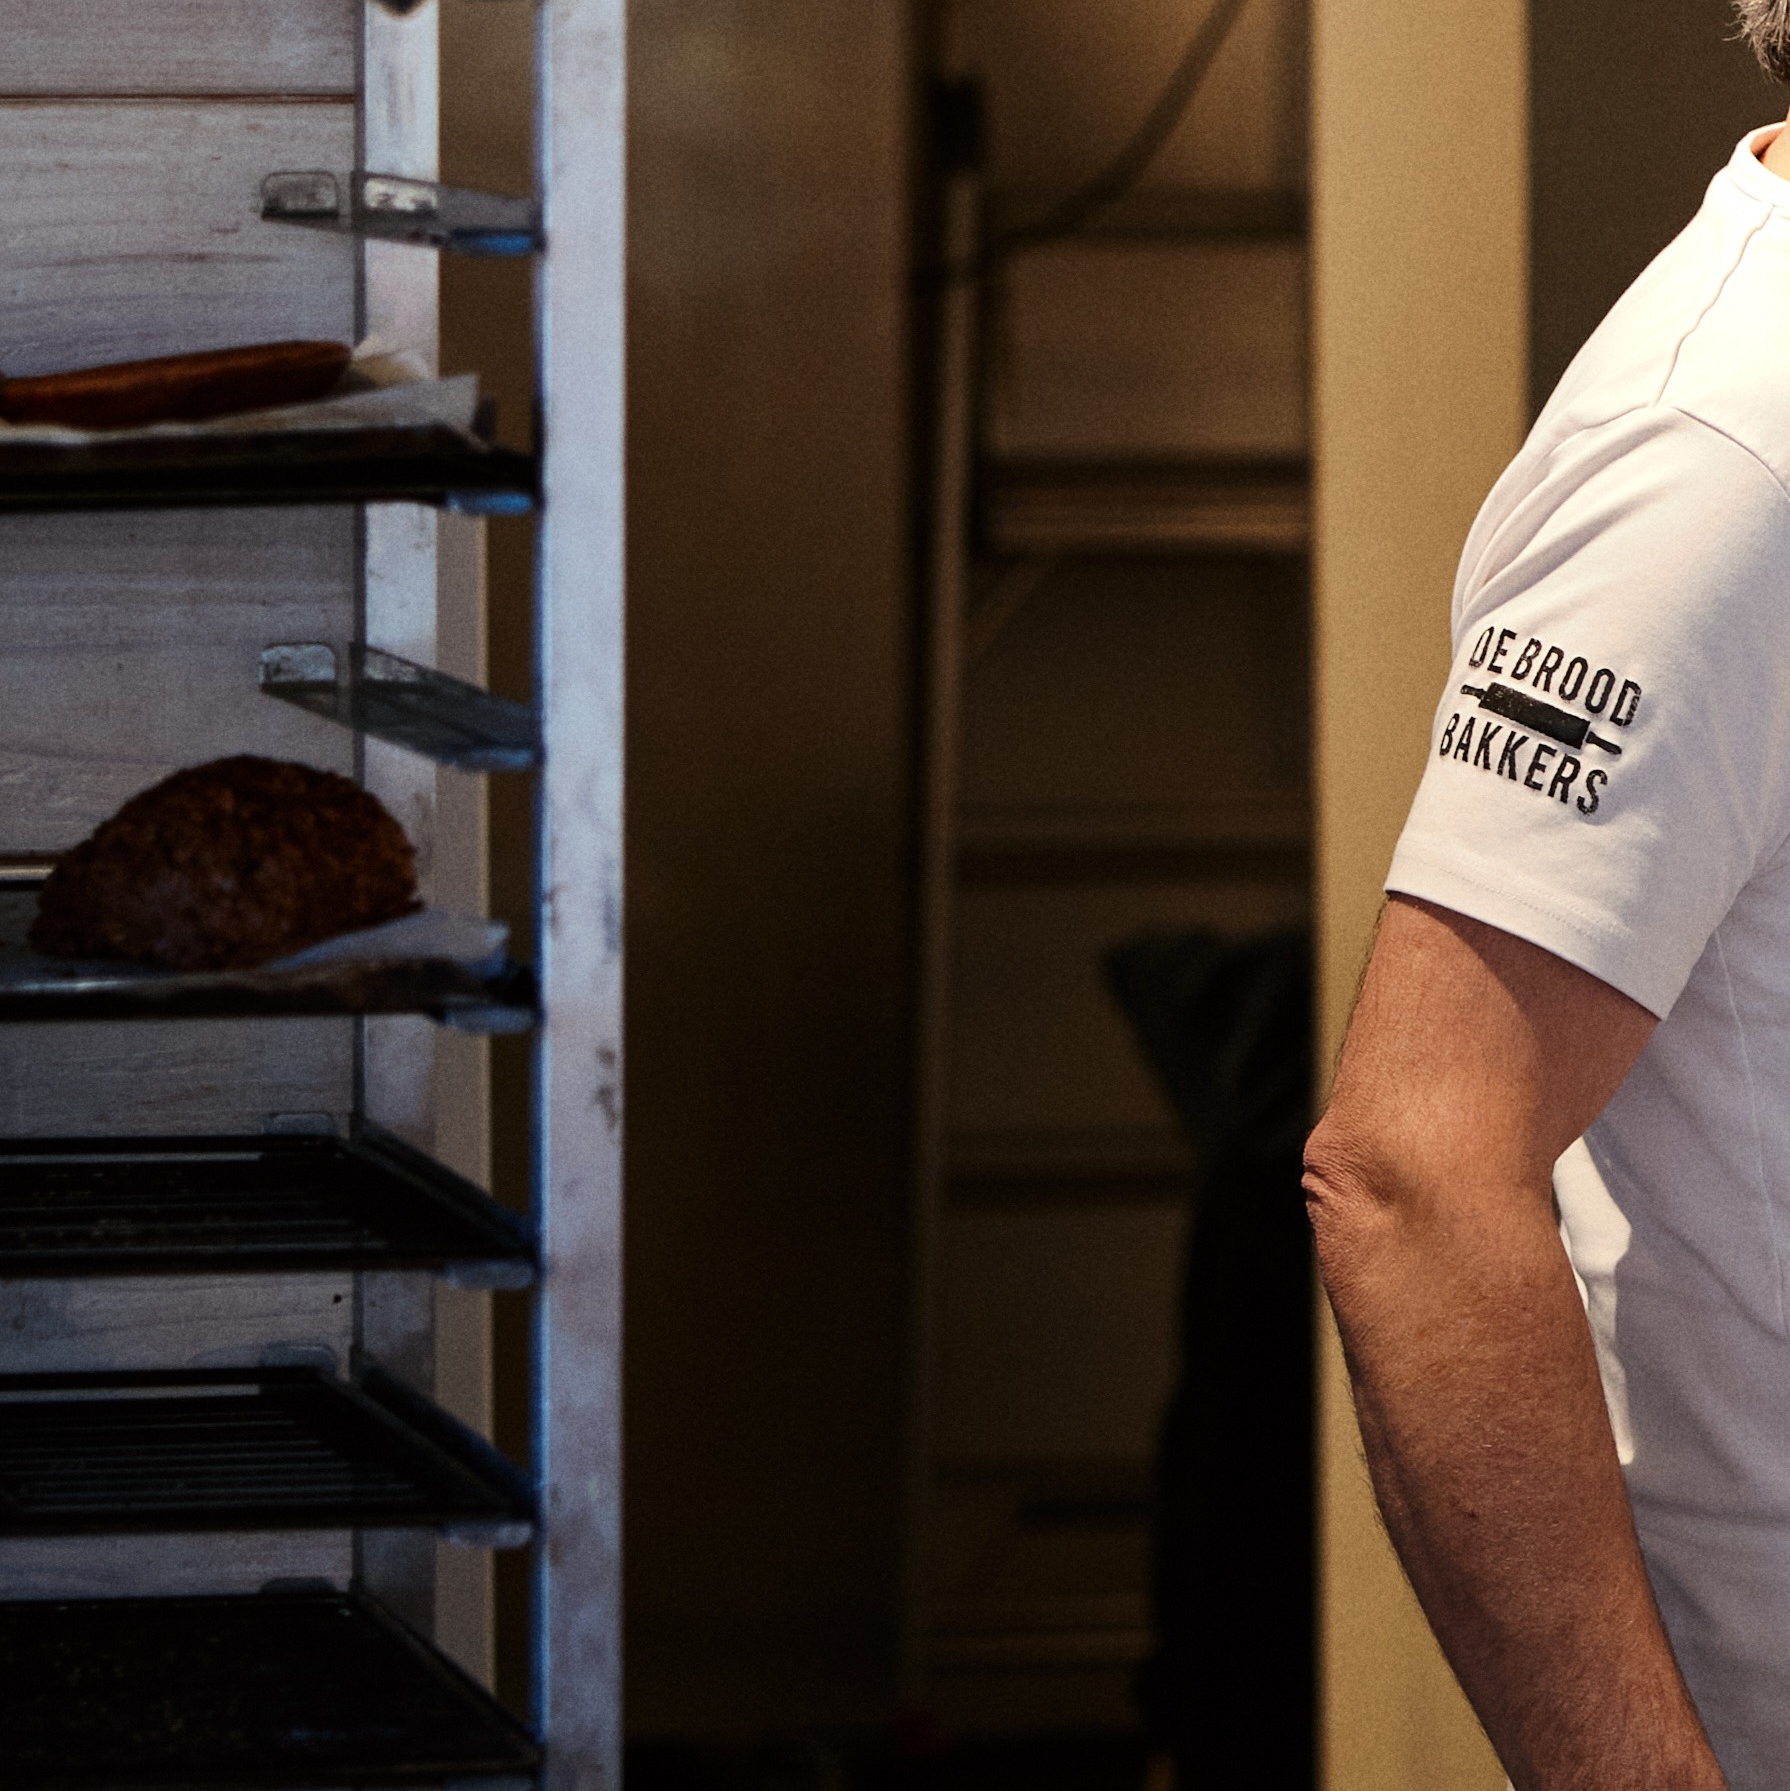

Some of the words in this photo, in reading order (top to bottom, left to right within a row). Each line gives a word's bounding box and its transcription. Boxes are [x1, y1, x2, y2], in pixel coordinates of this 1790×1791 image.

[1468, 626, 1517, 674] DE
[1510, 638, 1642, 727] BROOD
[1439, 713, 1608, 816] BAKKERS
